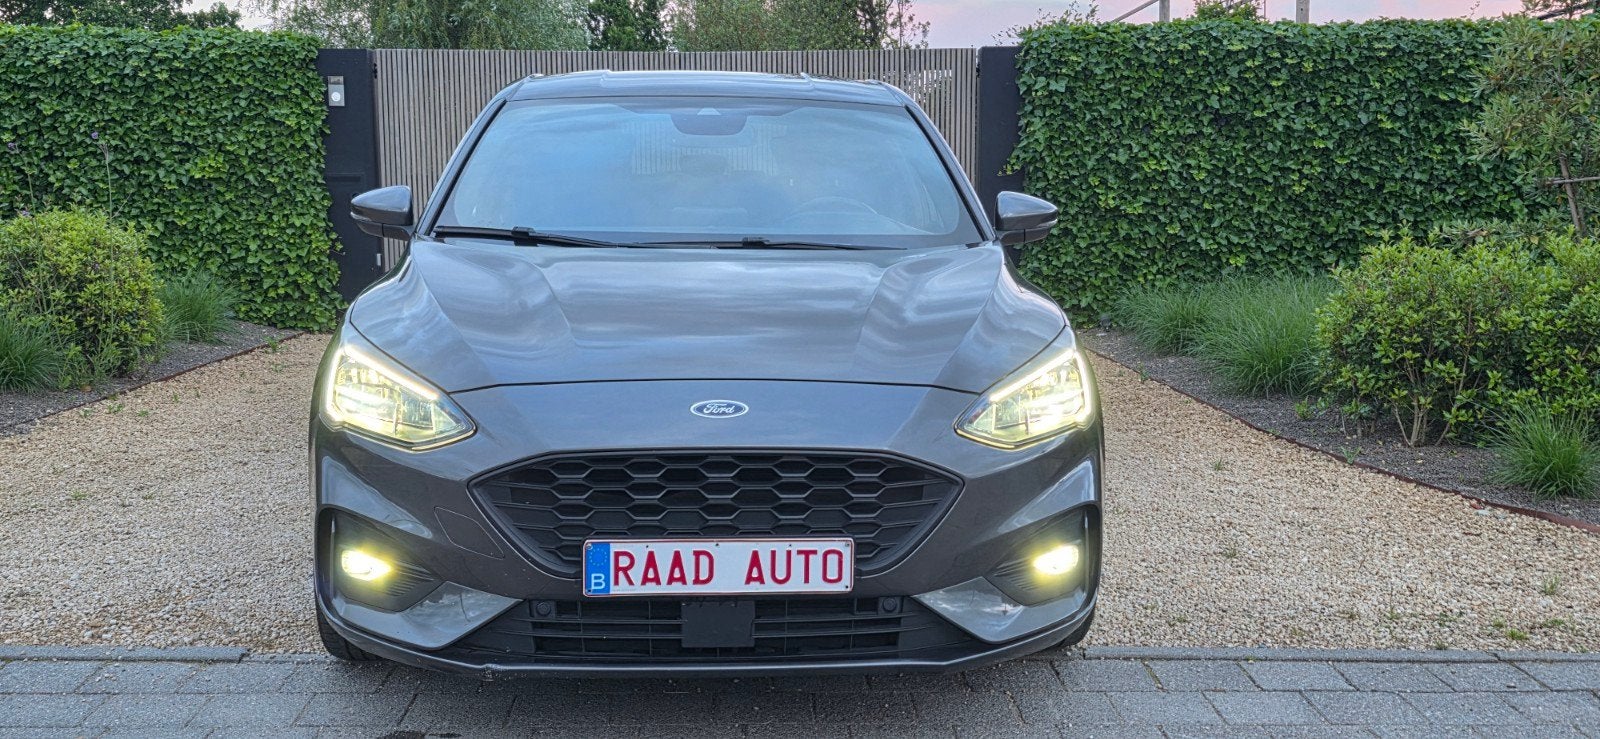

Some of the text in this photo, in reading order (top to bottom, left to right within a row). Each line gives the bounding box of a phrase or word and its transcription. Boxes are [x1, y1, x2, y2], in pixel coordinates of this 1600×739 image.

[703, 402, 735, 414] Ford
[613, 549, 844, 586] RAAD AUTO
[591, 573, 606, 590] B
